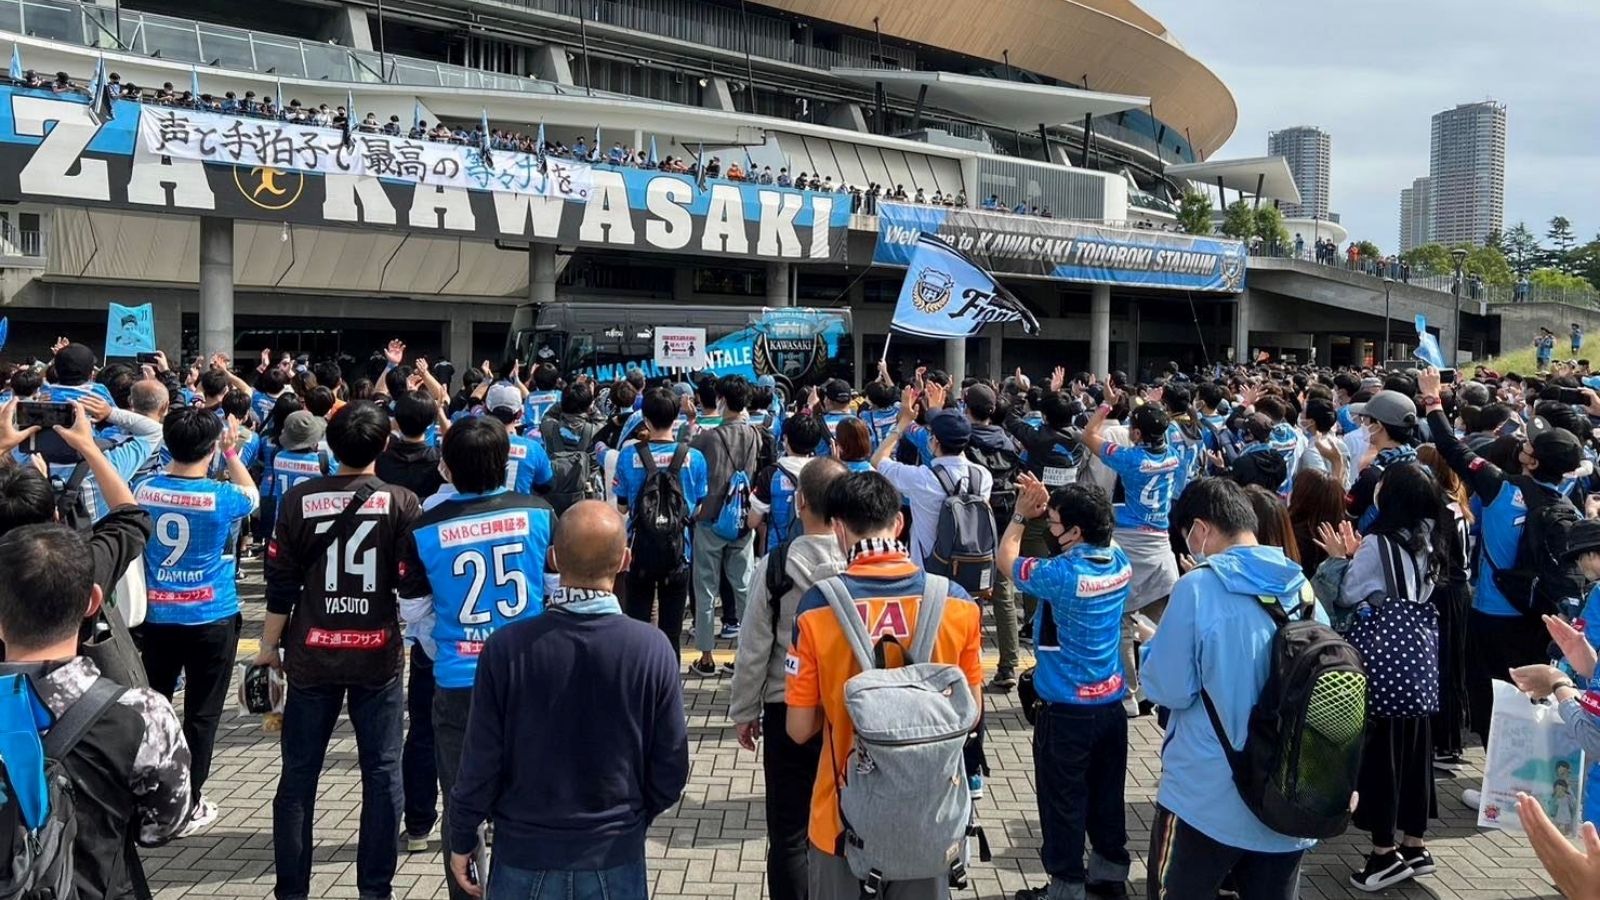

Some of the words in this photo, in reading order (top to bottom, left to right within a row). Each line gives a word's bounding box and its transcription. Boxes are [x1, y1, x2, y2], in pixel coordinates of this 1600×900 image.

[885, 226, 954, 246] Welce
[957, 232, 973, 251] to
[974, 231, 1071, 263] KAWASAKI
[1074, 242, 1152, 270] TODOROKI
[1153, 250, 1217, 275] STADIUM
[671, 345, 752, 376] NTALE
[769, 340, 811, 350] KAWASAKI
[156, 512, 190, 567] 9
[315, 520, 377, 592] 14
[453, 542, 528, 624] 25
[325, 597, 369, 614] YASUTO
[310, 630, 382, 645] 富士通エフサス
